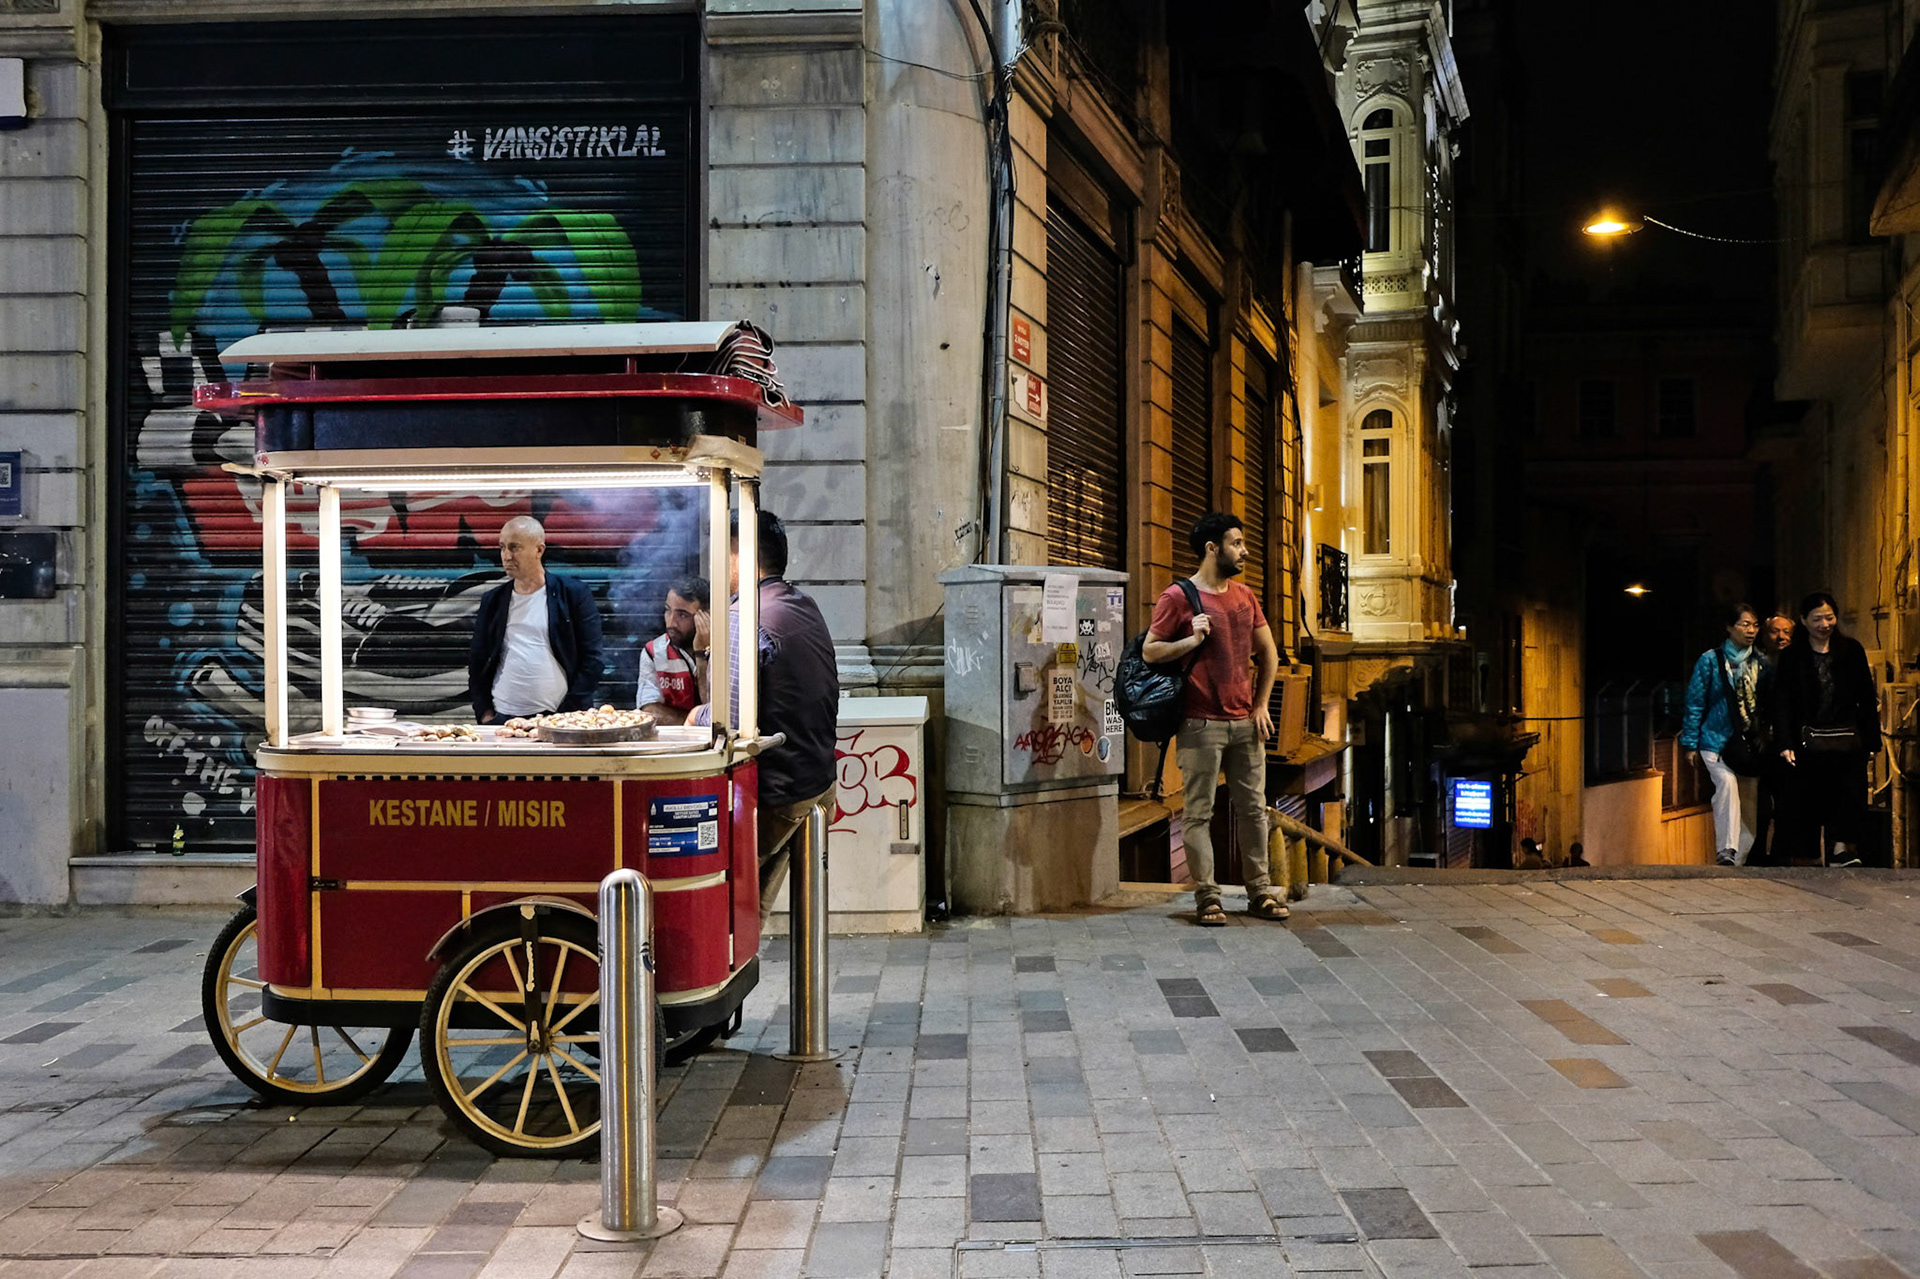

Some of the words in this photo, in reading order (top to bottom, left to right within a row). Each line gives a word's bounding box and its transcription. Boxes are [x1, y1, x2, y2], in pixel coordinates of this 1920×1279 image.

[1053, 676, 1073, 685] BOYA
[1105, 716, 1123, 725] WAS
[1105, 724, 1123, 734] HERE
[368, 799, 478, 827] KESTANE
[498, 799, 567, 828] MISIR
